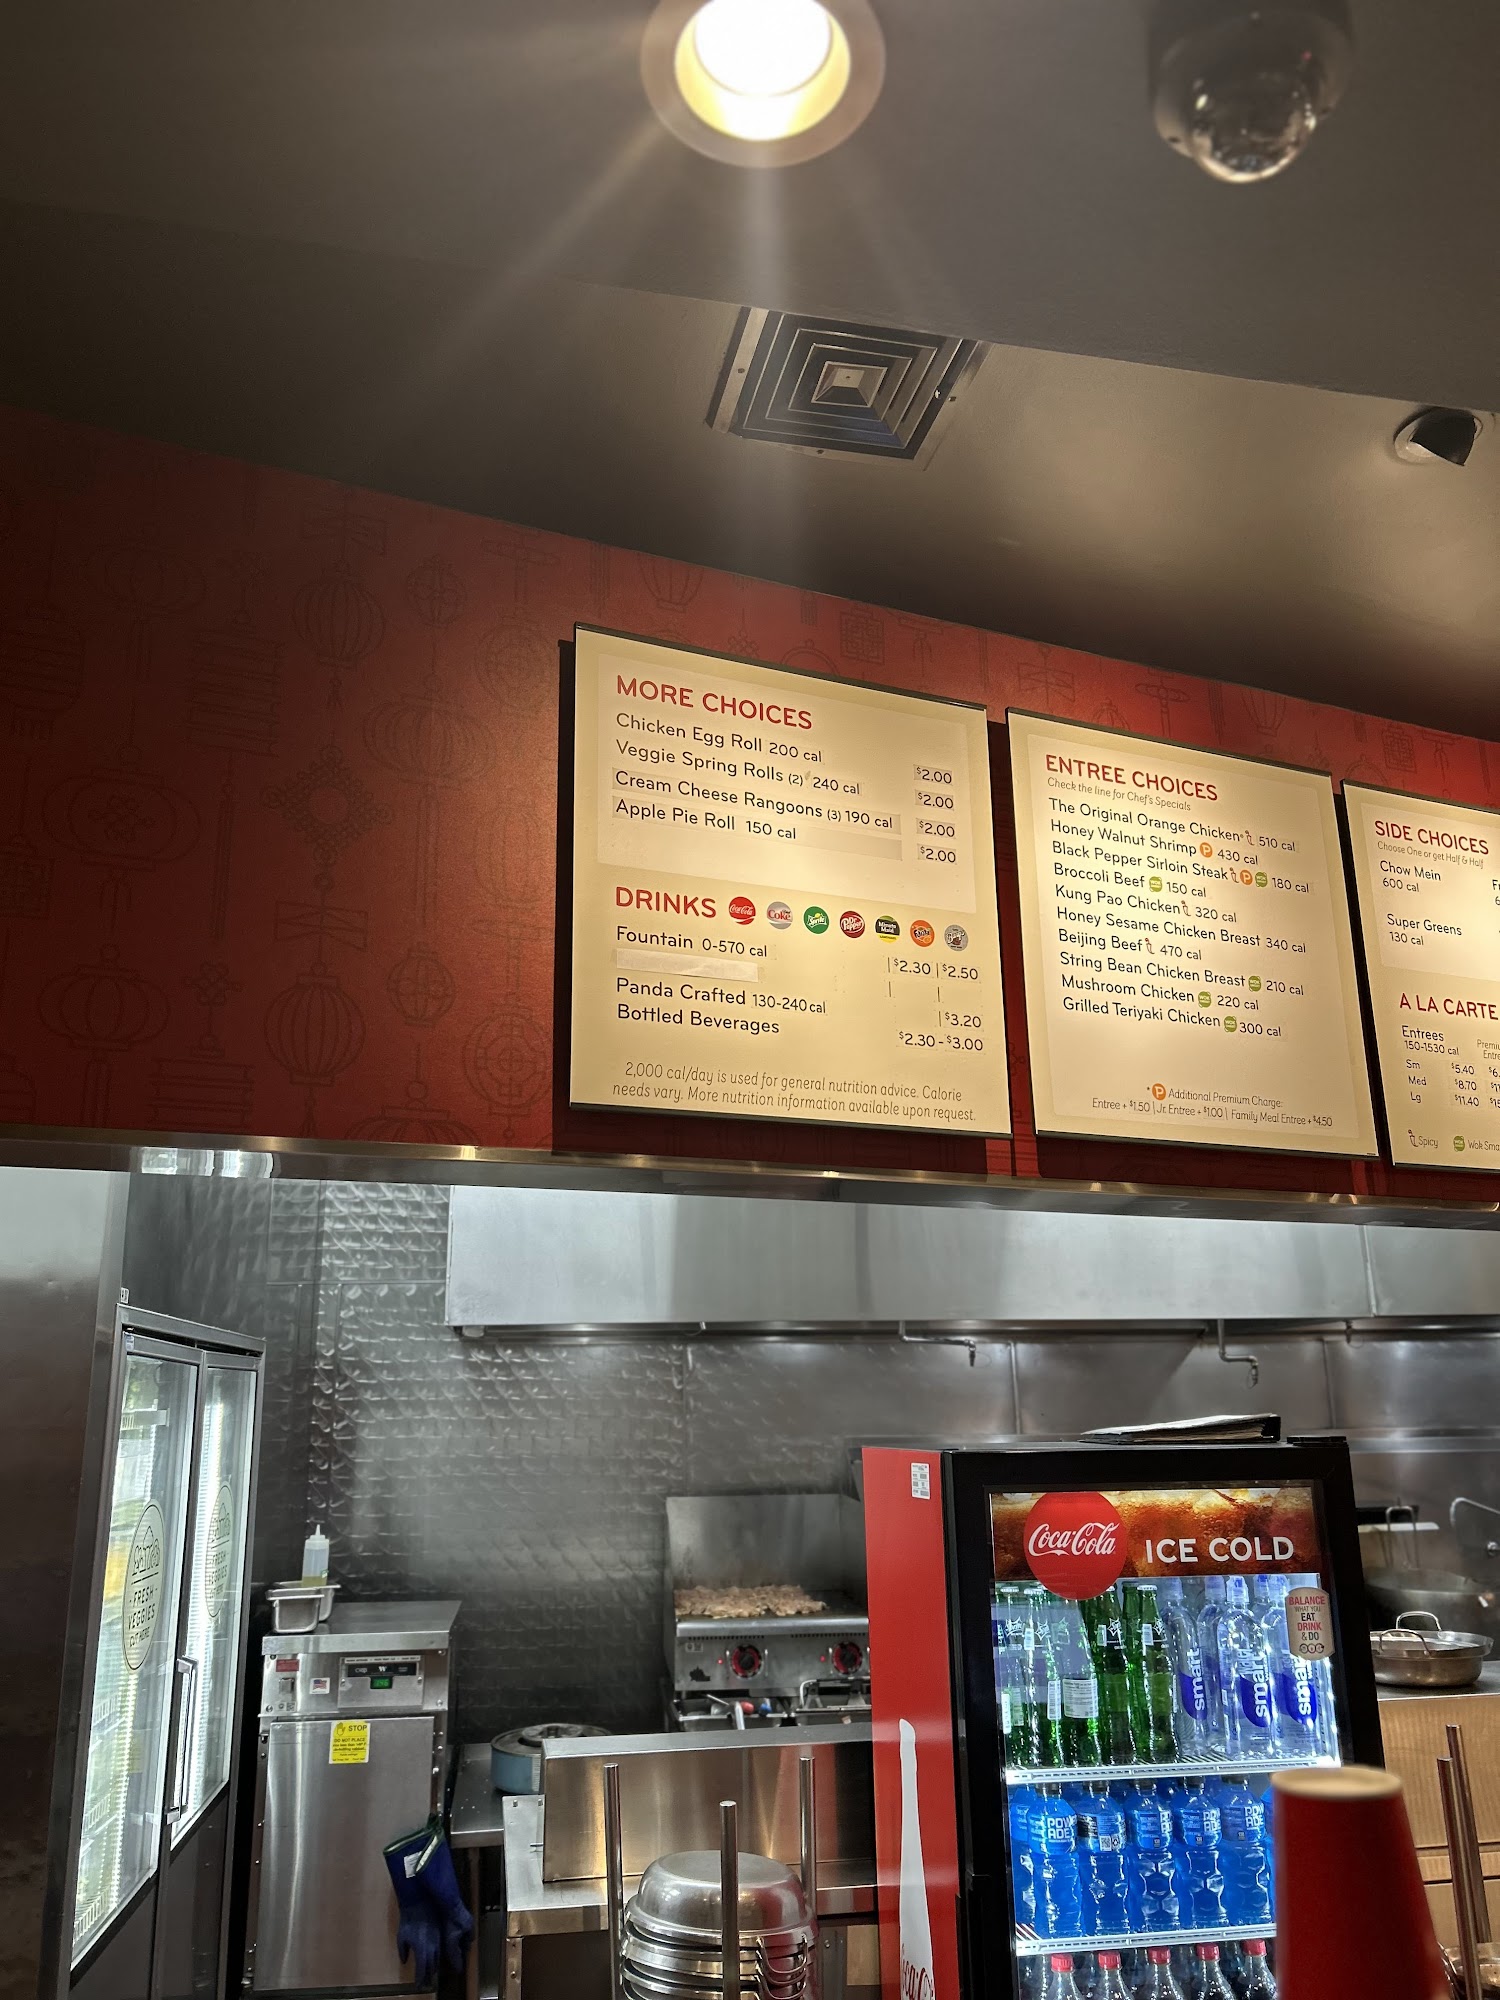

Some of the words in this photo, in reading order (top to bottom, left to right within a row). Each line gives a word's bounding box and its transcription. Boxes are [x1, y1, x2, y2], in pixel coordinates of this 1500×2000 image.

[617, 674, 693, 707] MORE
[702, 692, 811, 729] CHOICES
[616, 712, 685, 738] Chicken
[693, 726, 724, 748] Egg
[731, 733, 761, 751] Roll
[769, 742, 798, 757] 200
[803, 750, 821, 762] cal
[616, 739, 675, 763] Veggie
[682, 751, 736, 776] Spring
[744, 761, 783, 781] Rolls
[788, 773, 803, 786] (2)
[812, 776, 838, 791] 240
[842, 783, 859, 794] cal
[916, 766, 952, 784] $2.00
[1046, 754, 1126, 784] ENTREE
[1132, 771, 1217, 800] CHOICES
[616, 770, 670, 792] Cream
[678, 780, 737, 803] Cheese
[744, 791, 822, 817] Rangoons
[827, 808, 841, 822] (3)
[845, 810, 869, 824] 190
[874, 817, 892, 828] cal
[917, 792, 953, 809] $2.00
[616, 798, 665, 820] Apple
[672, 807, 697, 824] Pie
[704, 812, 734, 830] Roll
[745, 820, 772, 835] 150
[777, 827, 795, 839] cal
[919, 820, 954, 837] $2.00
[1048, 797, 1075, 813] The
[1079, 803, 1132, 823] Original
[1137, 813, 1185, 834] Orange
[1259, 836, 1277, 848] 510
[1281, 841, 1295, 851] cal
[1051, 818, 1094, 840] Honey
[1097, 826, 1145, 845] Walnut
[1149, 835, 1196, 857] Shrimp
[1217, 849, 1240, 861] 430
[1243, 855, 1257, 864] cal
[1374, 820, 1413, 841] SIDE
[1417, 828, 1488, 854] CHOICES
[920, 845, 956, 863] $2.00
[1052, 840, 1089, 858] Black
[1094, 847, 1142, 866] Pepper
[1146, 855, 1187, 873] Sirloin
[1192, 862, 1228, 879] Steak
[1271, 877, 1291, 889] 180
[1295, 883, 1308, 892] cal
[1379, 860, 1410, 875] Chow
[1414, 865, 1440, 880] Mein
[1054, 862, 1108, 882] Broccoli
[1114, 871, 1144, 887] Beef
[1166, 881, 1187, 894] 150
[1191, 887, 1206, 897] cal
[1382, 877, 1403, 889] 600
[1406, 882, 1419, 892] cal
[616, 886, 716, 918] DRINKS
[1055, 883, 1091, 904] Kung
[1097, 890, 1122, 905] Pao
[1127, 894, 1180, 914] Chicken
[1195, 906, 1218, 919] 320
[1221, 912, 1236, 922] cal
[1057, 906, 1100, 927] Honey
[1105, 913, 1158, 932] Sesame
[1163, 921, 1215, 940] Chicken
[1220, 929, 1260, 946] Breast
[1266, 937, 1288, 950] 340
[1291, 942, 1305, 953] cal
[1387, 913, 1418, 930] Super
[1423, 919, 1462, 935] Greens
[1389, 931, 1407, 943] 130
[1410, 935, 1423, 945] cal
[617, 925, 692, 948] Fountain
[702, 938, 744, 954] 0-570
[749, 945, 766, 957] cal
[1058, 928, 1105, 950] Beijing
[1111, 935, 1142, 951] Beef
[1160, 944, 1182, 957] 470
[1186, 949, 1201, 960] cal
[893, 958, 930, 974] $2.30
[942, 963, 978, 980] $2.50
[1060, 951, 1102, 972] String
[1107, 957, 1141, 974] Bean
[1146, 962, 1199, 981] Chicken
[1204, 969, 1245, 986] Breast
[1266, 980, 1285, 992] 210
[1289, 984, 1303, 995] cal
[617, 977, 672, 997] Panda
[680, 984, 745, 1004] Crafted
[752, 994, 807, 1011] 130-240
[809, 1001, 825, 1013] cal
[1061, 974, 1135, 995] Mushroom
[1140, 983, 1194, 1002] Chicken
[1217, 994, 1240, 1008] 220
[1243, 999, 1258, 1010] cal
[1399, 992, 1411, 1009] A
[1415, 994, 1438, 1013] LA
[1443, 998, 1498, 1020] CARTE
[618, 1003, 682, 1024] Bottled
[690, 1010, 779, 1035] Beverages
[944, 1011, 981, 1027] $3.20
[1063, 996, 1108, 1014] Grilled
[1112, 1002, 1162, 1021] Teriyaki
[1167, 1008, 1220, 1026] Chicken
[1239, 1022, 1262, 1034] 300
[1266, 1026, 1281, 1036] cal
[1401, 1025, 1443, 1041] Entrees
[1404, 1040, 1444, 1053] 150-1530
[1447, 1047, 1459, 1055] cal
[1405, 1058, 1420, 1069] Sm
[1451, 1062, 1474, 1074] $5.40
[625, 1061, 662, 1078] 2,000
[666, 1065, 713, 1085] cal/day
[717, 1069, 726, 1083] is
[730, 1071, 758, 1085] used
[760, 1071, 778, 1089] for
[781, 1077, 825, 1091] general
[828, 1080, 876, 1094] nutrition
[880, 1082, 918, 1097] advice.
[922, 1085, 961, 1101] Calorie
[1408, 1075, 1426, 1085] Med
[1454, 1078, 1476, 1090] $8.70
[612, 1082, 650, 1097] needs
[653, 1087, 683, 1103] vary.
[687, 1086, 718, 1102] More
[722, 1091, 773, 1106] nutrition
[777, 1093, 845, 1111] information
[848, 1099, 899, 1115] available
[902, 1106, 930, 1119] upon
[933, 1108, 975, 1122] request.
[1410, 1091, 1421, 1103] Lg
[1028, 1522, 1120, 1557] Coca-Cola
[1145, 1539, 1198, 1563] ICE
[1209, 1536, 1294, 1562] COLD
[132, 1587, 153, 1608] FRESH
[1288, 1596, 1326, 1606] BALANCE
[128, 1604, 155, 1630] VEGGIES
[1297, 1622, 1322, 1632] DRINK
[1308, 1632, 1320, 1641] DO
[1186, 1648, 1206, 1711] smart
[1250, 1651, 1269, 1718] smart
